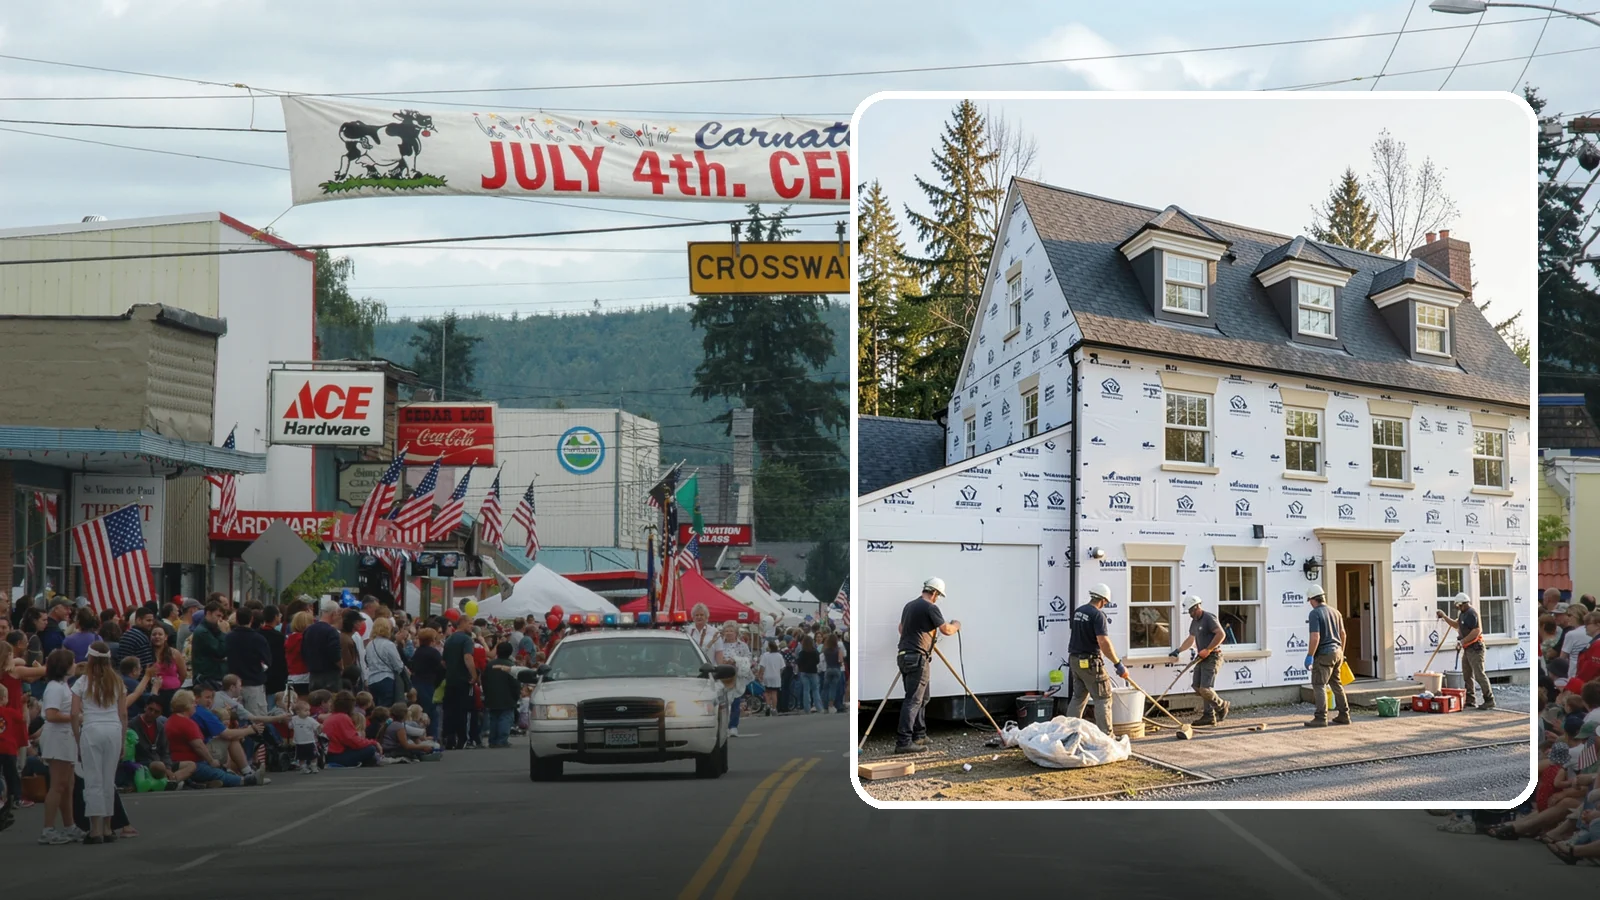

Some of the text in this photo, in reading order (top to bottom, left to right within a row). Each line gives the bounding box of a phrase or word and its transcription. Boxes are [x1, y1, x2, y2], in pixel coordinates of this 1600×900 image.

[481, 141, 605, 193] JULY
[632, 150, 747, 197] 4th.
[697, 254, 850, 280] CROSSWA
[283, 380, 373, 419] ACE
[405, 409, 485, 422] CEDAR LOG
[283, 421, 370, 436] Hardware
[416, 428, 477, 447] Coca-Cola
[96, 485, 124, 495] Vincent
[126, 485, 136, 495] de
[138, 486, 155, 496] Paul
[212, 516, 334, 535] HARDARE
[688, 526, 742, 535] CRNATION
[699, 535, 730, 544] GLASS
